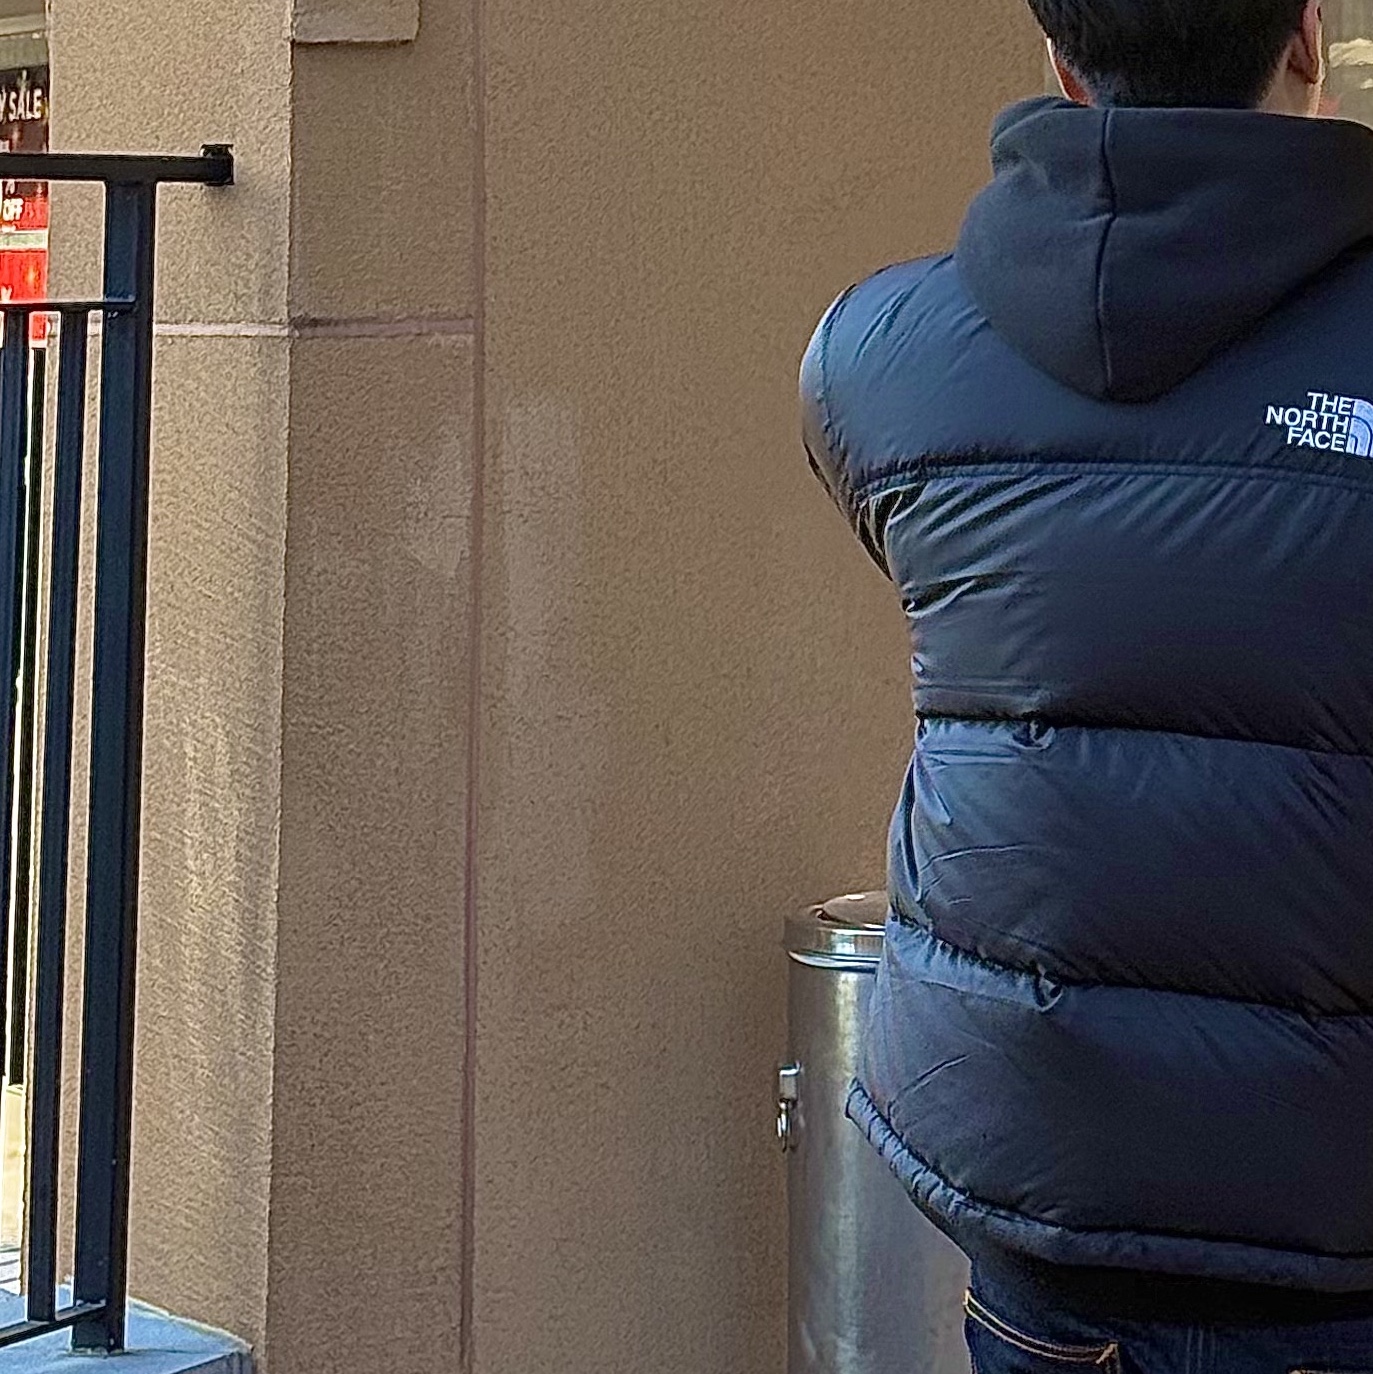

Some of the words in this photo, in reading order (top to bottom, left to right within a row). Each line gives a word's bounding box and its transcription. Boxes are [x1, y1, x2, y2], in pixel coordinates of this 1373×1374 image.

[9, 87, 42, 121] SALE
[1307, 391, 1353, 416] THE
[1265, 405, 1349, 434] NORTH
[1286, 426, 1346, 453] FACE
